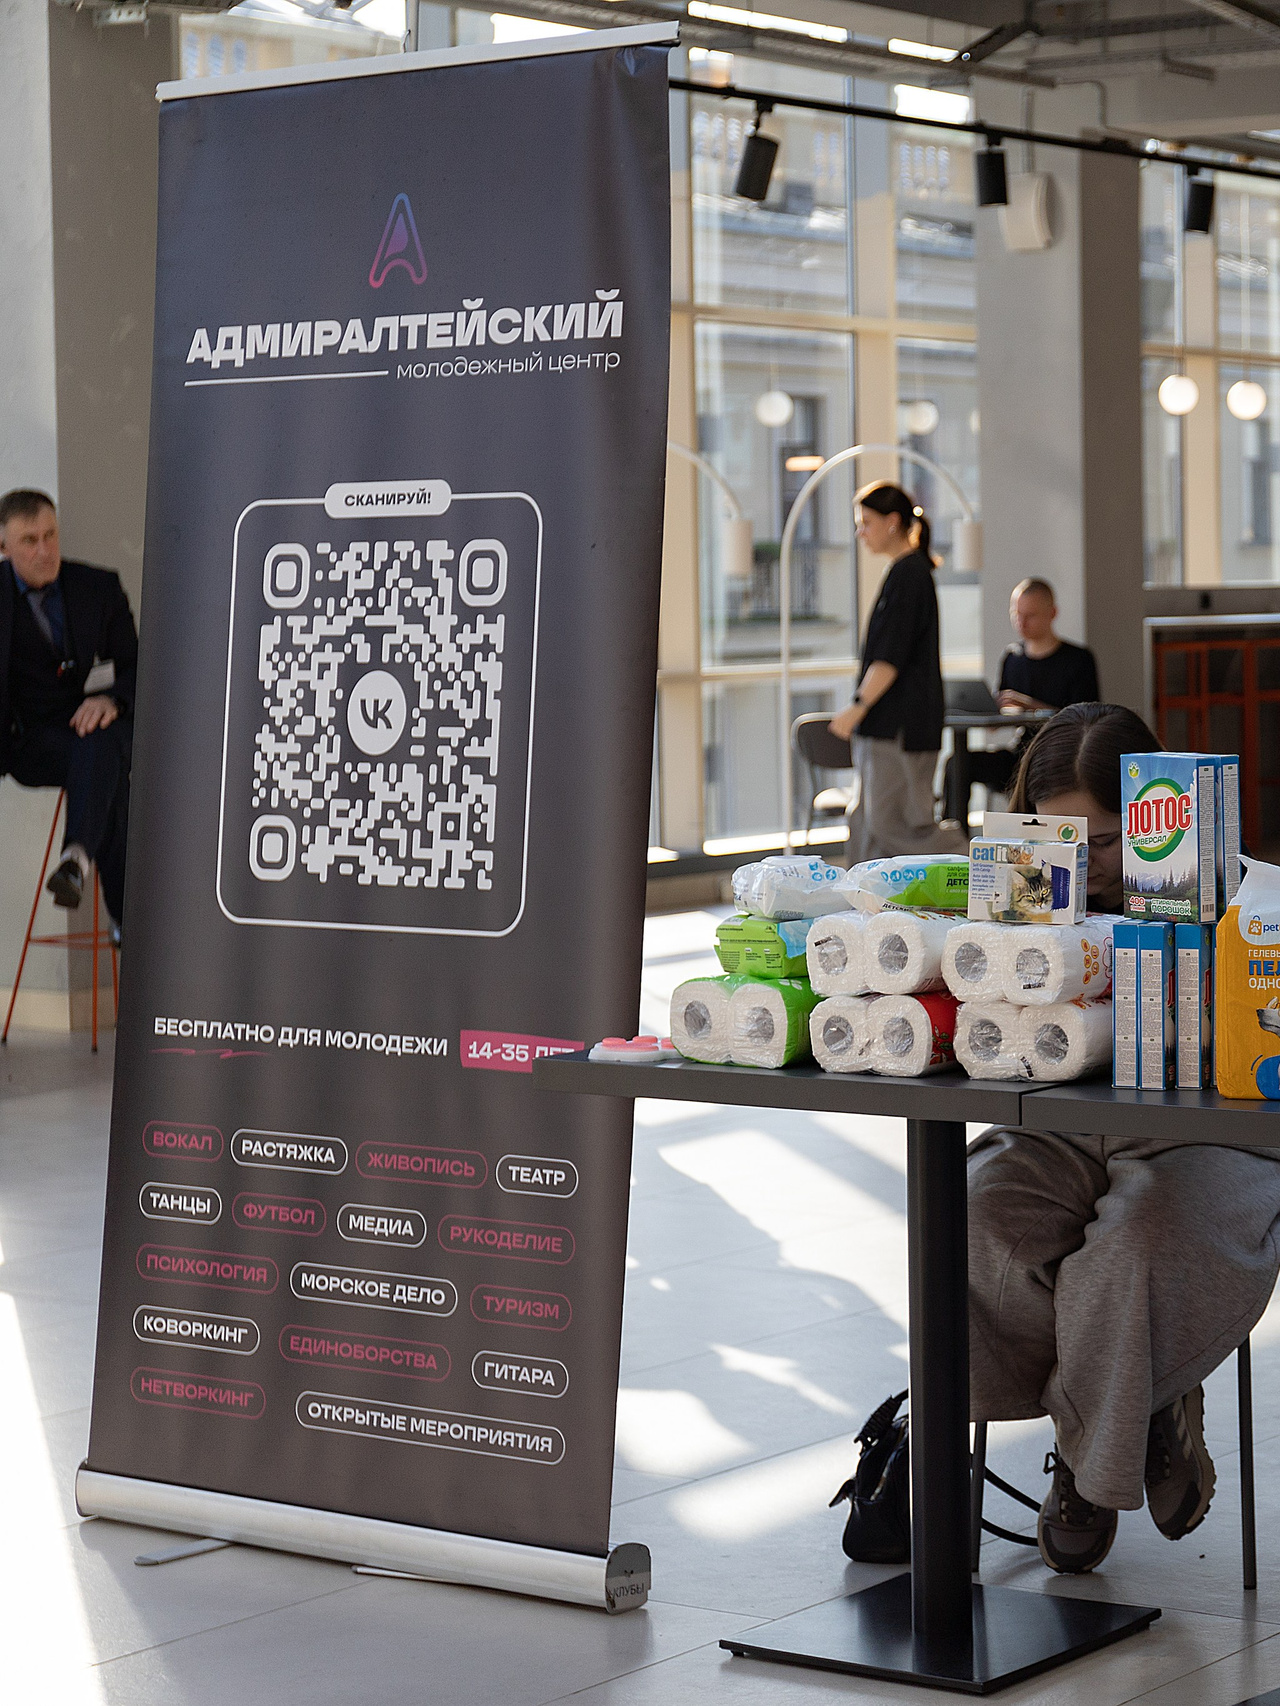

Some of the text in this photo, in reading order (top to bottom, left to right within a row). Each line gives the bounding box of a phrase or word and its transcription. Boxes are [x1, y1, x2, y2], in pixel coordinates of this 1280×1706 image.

[185, 289, 624, 369] АДМИРАЛТЕЙСКИЙ
[396, 350, 621, 379] молодежный центр
[343, 488, 432, 507] СКАНИРУЙ!
[1127, 794, 1192, 837] ЛОТОС
[1127, 835, 1167, 847] УНИВЕРСАЛ
[1129, 896, 1145, 905] 400
[1151, 905, 1190, 914] ПОРОШОК
[154, 1017, 449, 1057] БЕСПЛАТНО ДЛЯ МОЛОДЕЖИ
[468, 1041, 529, 1062] 14-35
[152, 1130, 213, 1152] ВОКАЛ
[241, 1139, 336, 1164] РАСТЯЖКА
[367, 1151, 476, 1177] ЖИВОПИСЬ
[508, 1165, 567, 1186] ТЕАТР
[149, 1192, 211, 1216] ТАНЦЫ
[243, 1203, 316, 1225] ФУТБОЛ
[348, 1214, 414, 1237] МЕДИА
[450, 1226, 563, 1253] РУКОДЕЛИЕ
[146, 1254, 268, 1283] ПСИХОЛОГИЯ
[301, 1272, 446, 1305] МОРСКОЕ ДЕЛО
[482, 1295, 560, 1320] ТУРИЗМ
[143, 1315, 249, 1343] КОВОРКИНГ
[289, 1335, 439, 1370] ЕДИНОБОРСТВА
[483, 1361, 556, 1387] ГИТАРА
[140, 1377, 255, 1408] НЕТВОРКИНГ
[307, 1402, 553, 1454] ОТКРЫТЫЕ МЕРОПРИЯТИЯ
[613, 1583, 645, 1598] КЛУБЫ
